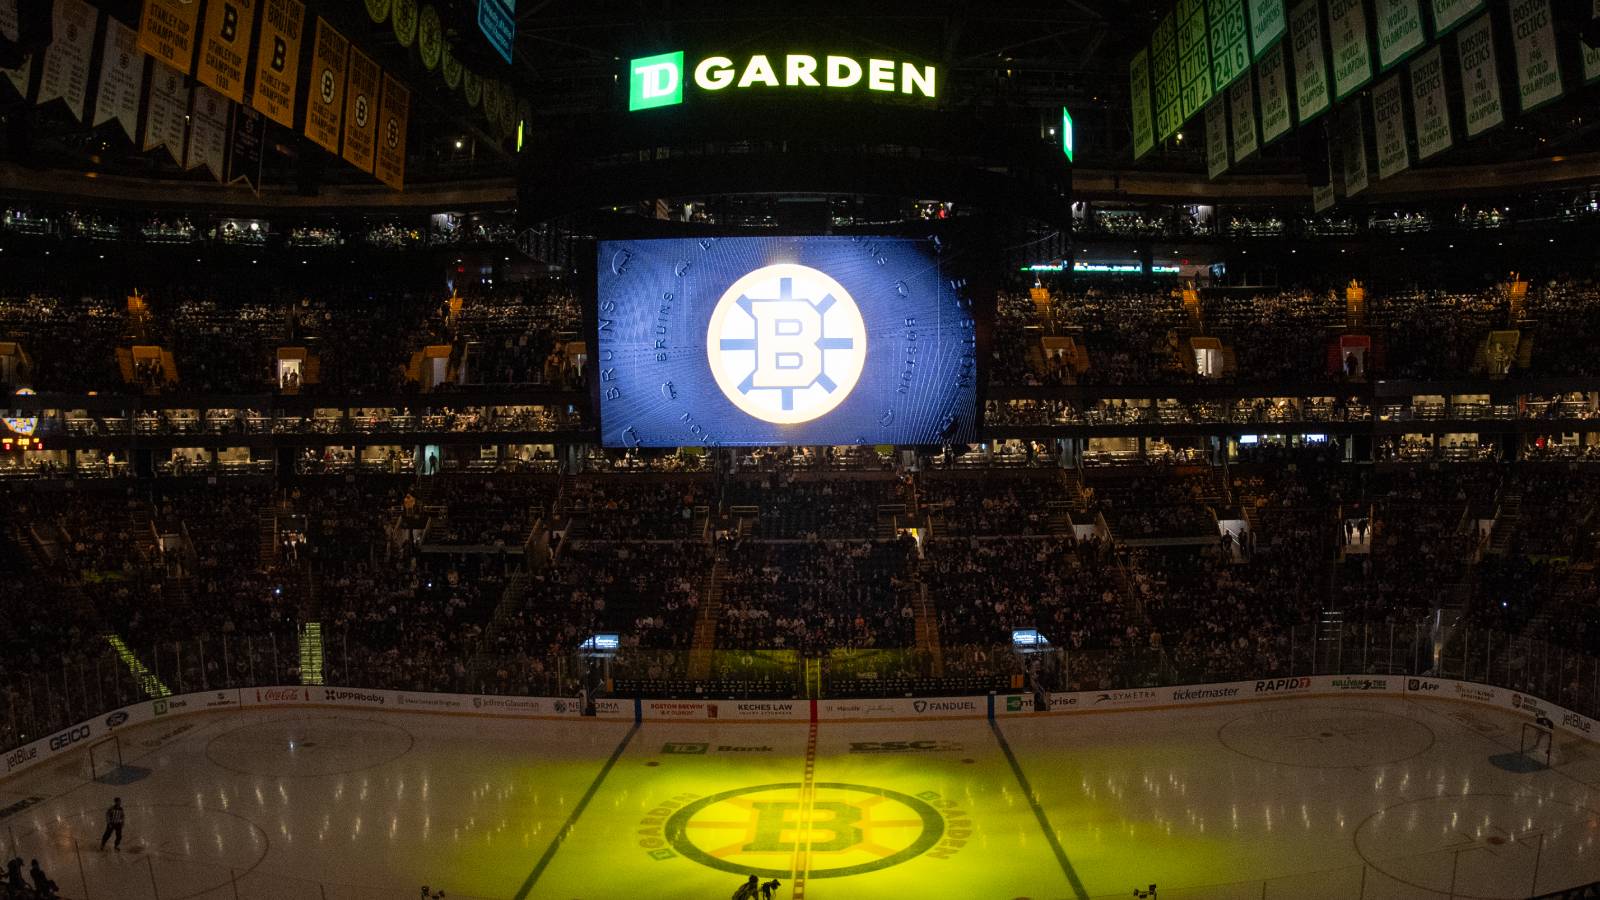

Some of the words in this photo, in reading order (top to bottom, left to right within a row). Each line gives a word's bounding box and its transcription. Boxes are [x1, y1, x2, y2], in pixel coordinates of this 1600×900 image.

[221, 2, 238, 42] B
[1227, 5, 1243, 40] 25
[1388, 6, 1408, 29] WORLD
[1513, 0, 1546, 22] BOSTON
[147, 18, 188, 51] CHAMPIONS
[1212, 22, 1227, 54] 21
[1382, 16, 1418, 49] CHAMPIONS
[1517, 10, 1547, 40] CELTICS
[1180, 26, 1191, 53] 19
[1461, 27, 1489, 55] BOSTON
[206, 53, 240, 82] CHAMPIONS
[271, 35, 287, 73] B
[1195, 42, 1207, 70] 18
[1236, 43, 1244, 69] 6
[1464, 45, 1489, 71] CELTICS
[635, 62, 677, 99] TD
[694, 54, 936, 98] GARDEN
[1182, 54, 1193, 84] 17
[1215, 55, 1230, 87] 24
[1413, 61, 1441, 85] BOSTON
[1527, 60, 1548, 80] WORLD
[1200, 76, 1208, 100] 2
[1416, 76, 1441, 99] CELTICS
[1522, 72, 1557, 97] CHAMPIONS
[1184, 86, 1196, 113] 10
[1469, 99, 1499, 124] CHAMPIONS
[653, 291, 675, 363] BRUINS
[598, 299, 620, 402] BRUINS
[752, 299, 824, 388] B
[737, 703, 770, 711] KECHES
[772, 703, 793, 711] LAW
[929, 701, 977, 711] FANDUEL
[1112, 692, 1156, 701] SYMETRA
[1173, 687, 1240, 700] ticketmaster
[1562, 713, 1592, 733] jetBlue
[49, 725, 91, 752] GEICO
[718, 745, 774, 753] Bank
[7, 747, 37, 772] jetBlue
[741, 802, 862, 853] B
